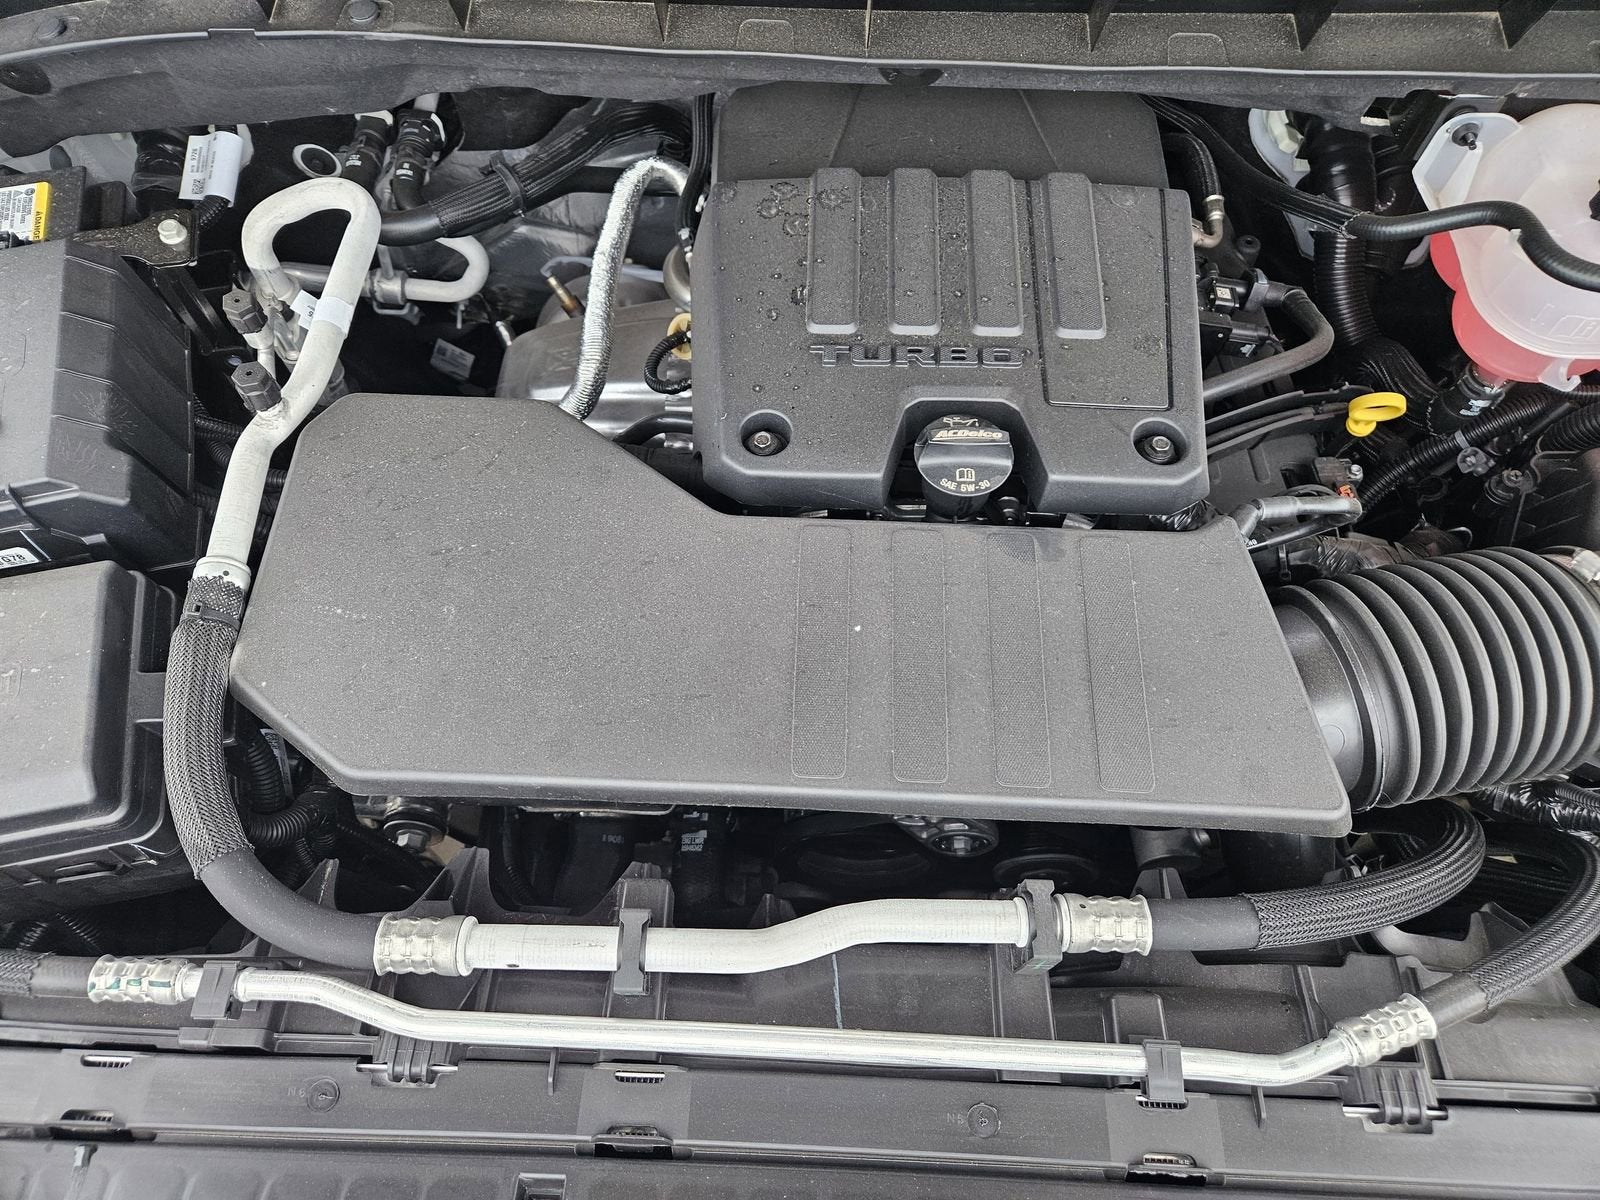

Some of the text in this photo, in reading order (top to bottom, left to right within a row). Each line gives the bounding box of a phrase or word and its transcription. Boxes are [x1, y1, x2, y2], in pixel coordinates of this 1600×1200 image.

[33, 216, 42, 240] DANGE
[809, 344, 1023, 369] TURBO
[932, 429, 1003, 440] ACDelco
[940, 478, 991, 492] SAE 5W-30
